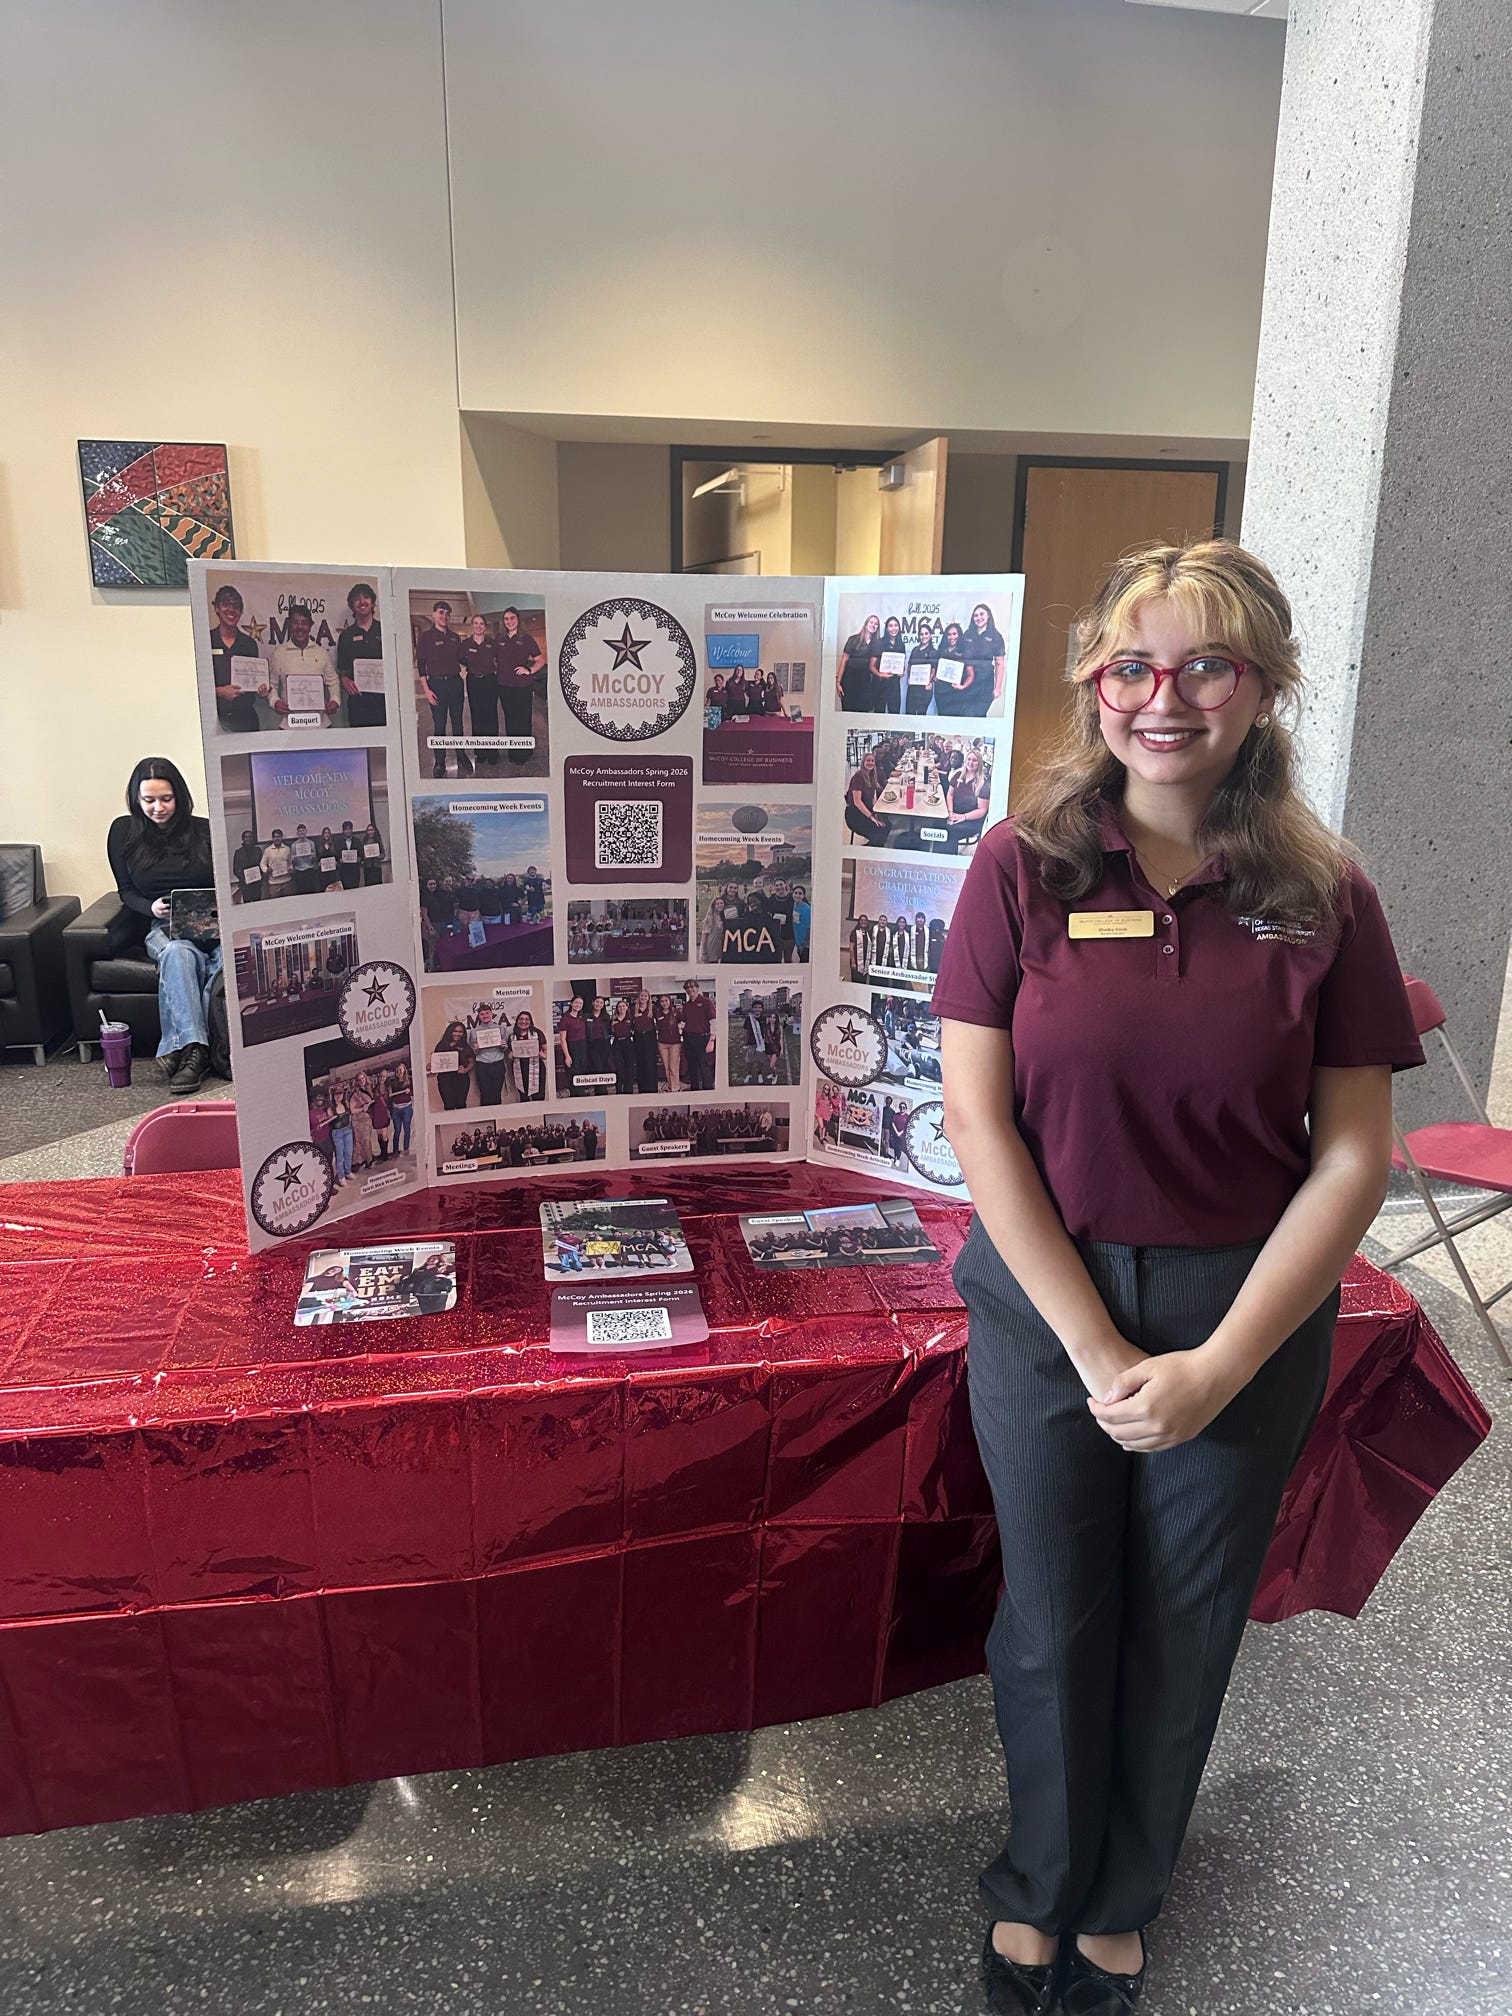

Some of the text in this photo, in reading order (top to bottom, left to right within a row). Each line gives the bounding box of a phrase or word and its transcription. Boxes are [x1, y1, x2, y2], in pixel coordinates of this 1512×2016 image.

[769, 611, 808, 619] Celebration
[922, 604, 940, 614] 2025
[269, 617, 336, 646] MA
[712, 644, 752, 660] Welcome
[591, 673, 665, 694] McCOY
[590, 697, 666, 708] AMBASSADORS
[291, 717, 318, 726] Banquet
[465, 739, 508, 747] Ambassador
[272, 773, 325, 786] WELCOME
[570, 768, 594, 776] McCoy
[645, 768, 669, 777] Spring
[670, 768, 688, 776] 2026
[582, 779, 626, 787] Recruitment
[628, 779, 655, 787] Interest
[278, 801, 348, 817] AMBASSADORS
[699, 835, 741, 843] Homecoming
[923, 831, 945, 839] Socials
[864, 866, 958, 884] CONGRATULATIONS
[878, 880, 940, 896] GRADUATING
[264, 926, 352, 946] McCoy Welcome Celebration
[723, 927, 775, 953] MCA
[891, 971, 928, 980] Ambassador
[355, 1003, 398, 1024] McCOY
[466, 1012, 511, 1029] MA
[355, 1018, 400, 1033] AMBASSADORS
[828, 1044, 869, 1063] McCOY
[826, 1057, 868, 1070] AMBASSADORS
[847, 1088, 877, 1107] MCA
[921, 1141, 956, 1159] McCO
[446, 1162, 475, 1170] Meetings
[272, 1179, 315, 1213] McCOY
[275, 1193, 320, 1222] AMBASSADORS
[622, 1242, 657, 1252] MCA
[359, 1265, 403, 1276] EAT
